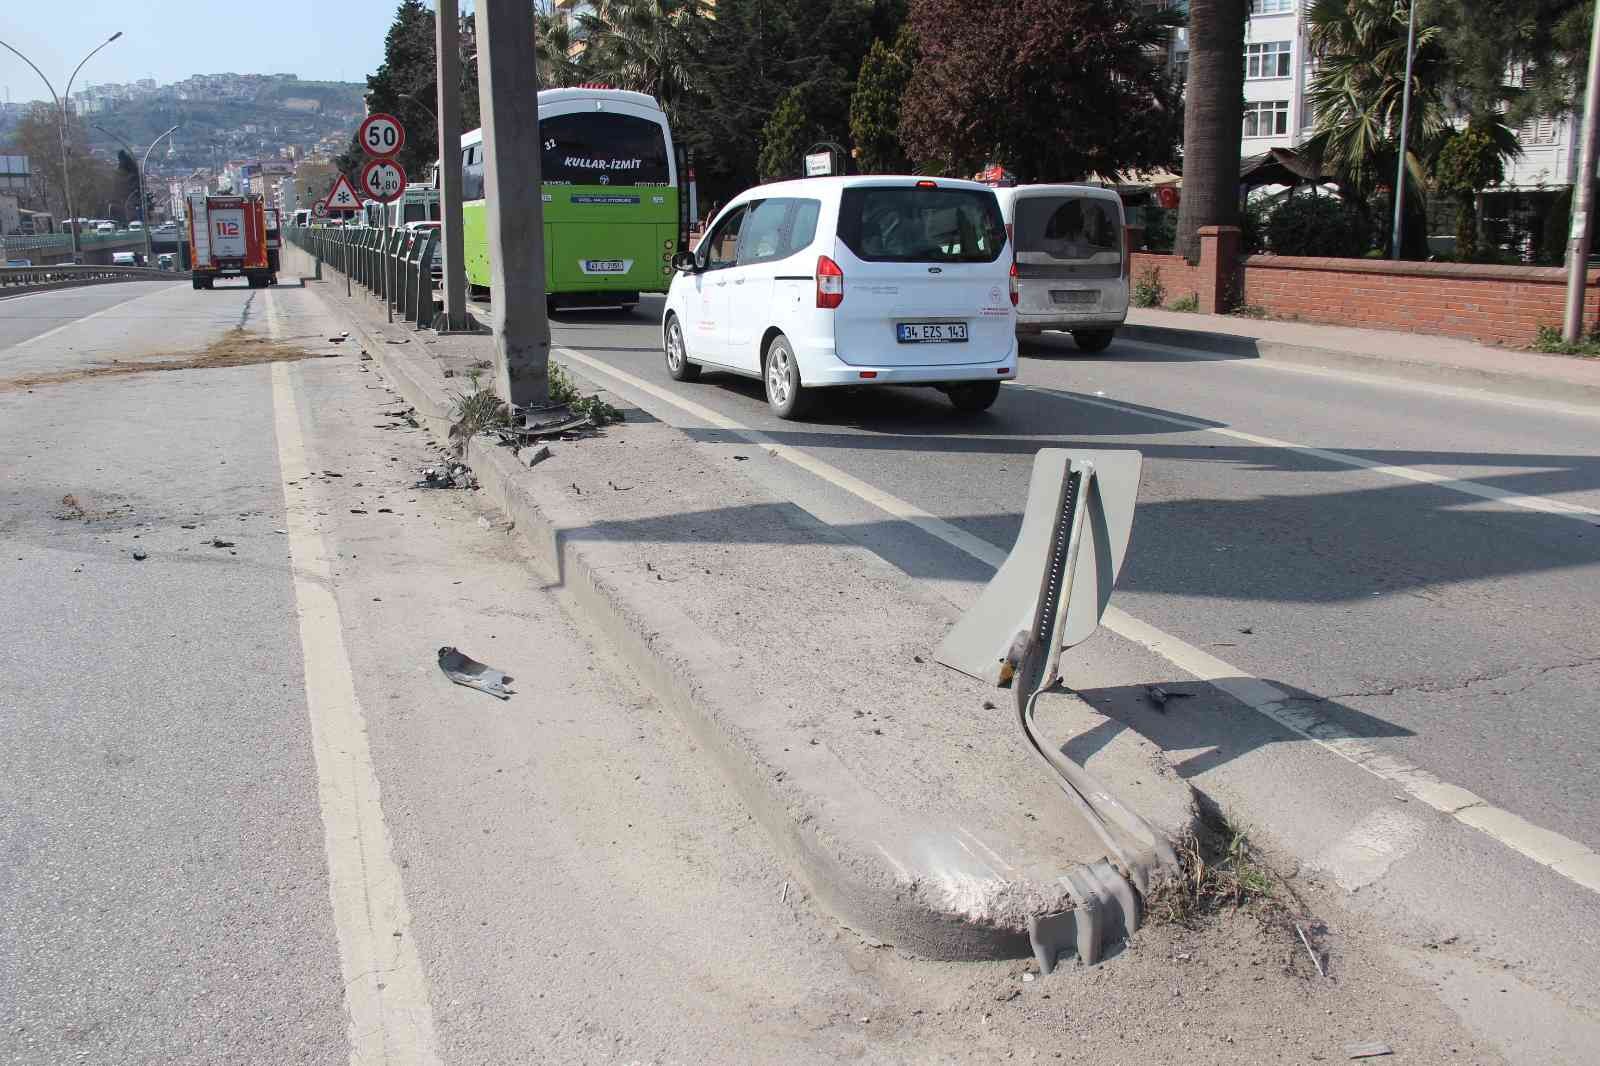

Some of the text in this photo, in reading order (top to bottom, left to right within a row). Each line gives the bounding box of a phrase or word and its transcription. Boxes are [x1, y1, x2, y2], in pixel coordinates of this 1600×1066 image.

[369, 126, 396, 146] 50
[544, 138, 557, 151] 32
[564, 156, 642, 170] KULLAR-İZMİT
[216, 222, 240, 236] 112
[905, 326, 965, 339] 34 EZS 143
